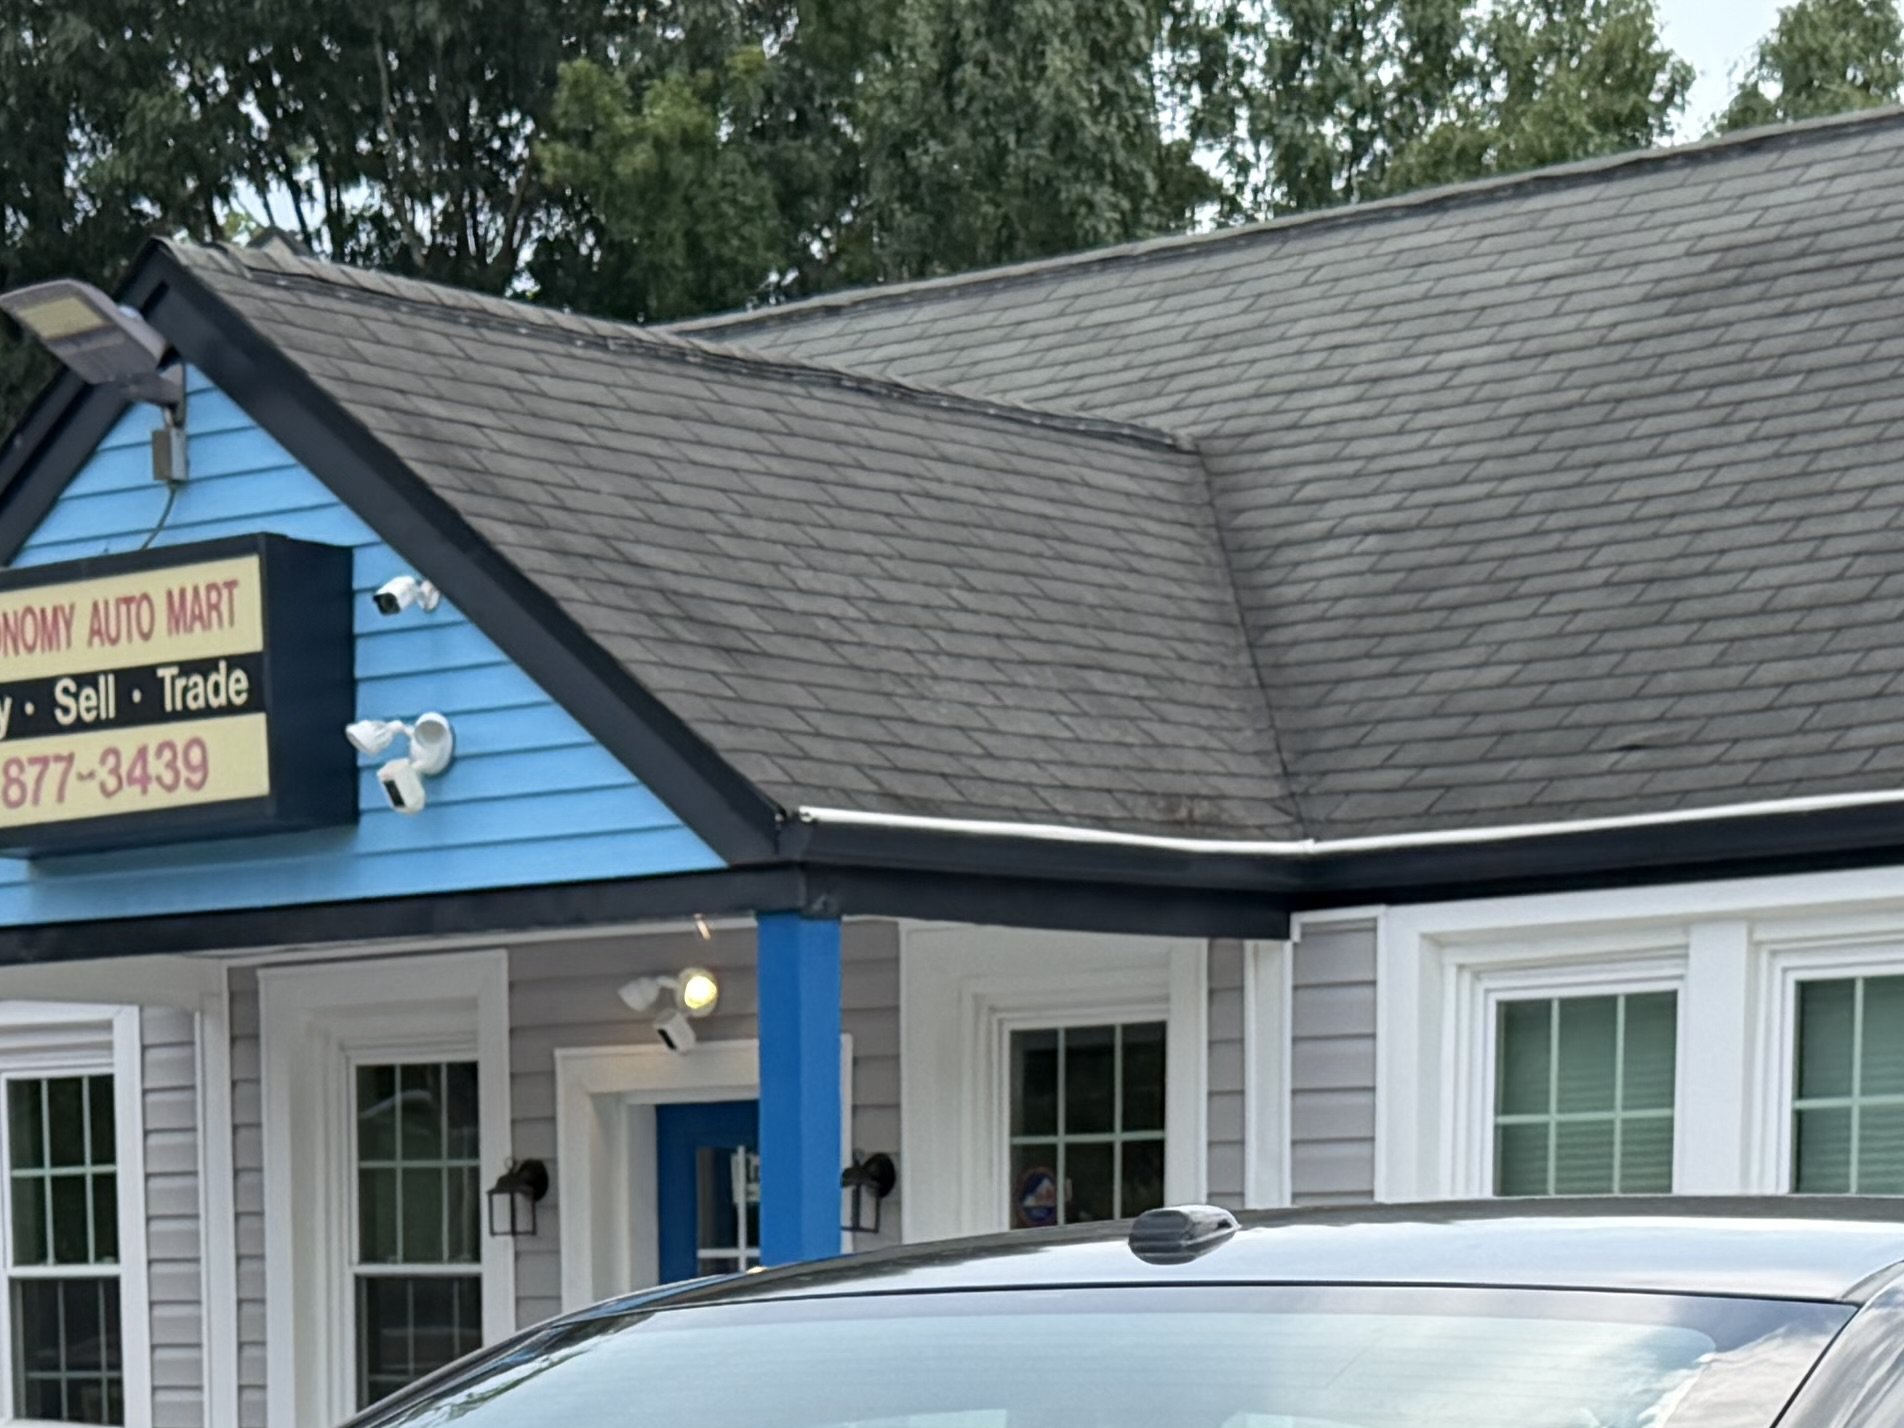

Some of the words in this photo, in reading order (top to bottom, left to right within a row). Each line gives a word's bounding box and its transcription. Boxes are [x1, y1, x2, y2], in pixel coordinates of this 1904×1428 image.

[87, 592, 155, 648] AUTO
[167, 579, 238, 637] MART
[54, 674, 115, 726] Sell
[157, 660, 249, 714] Trade
[0, 736, 210, 810] 877-3439
